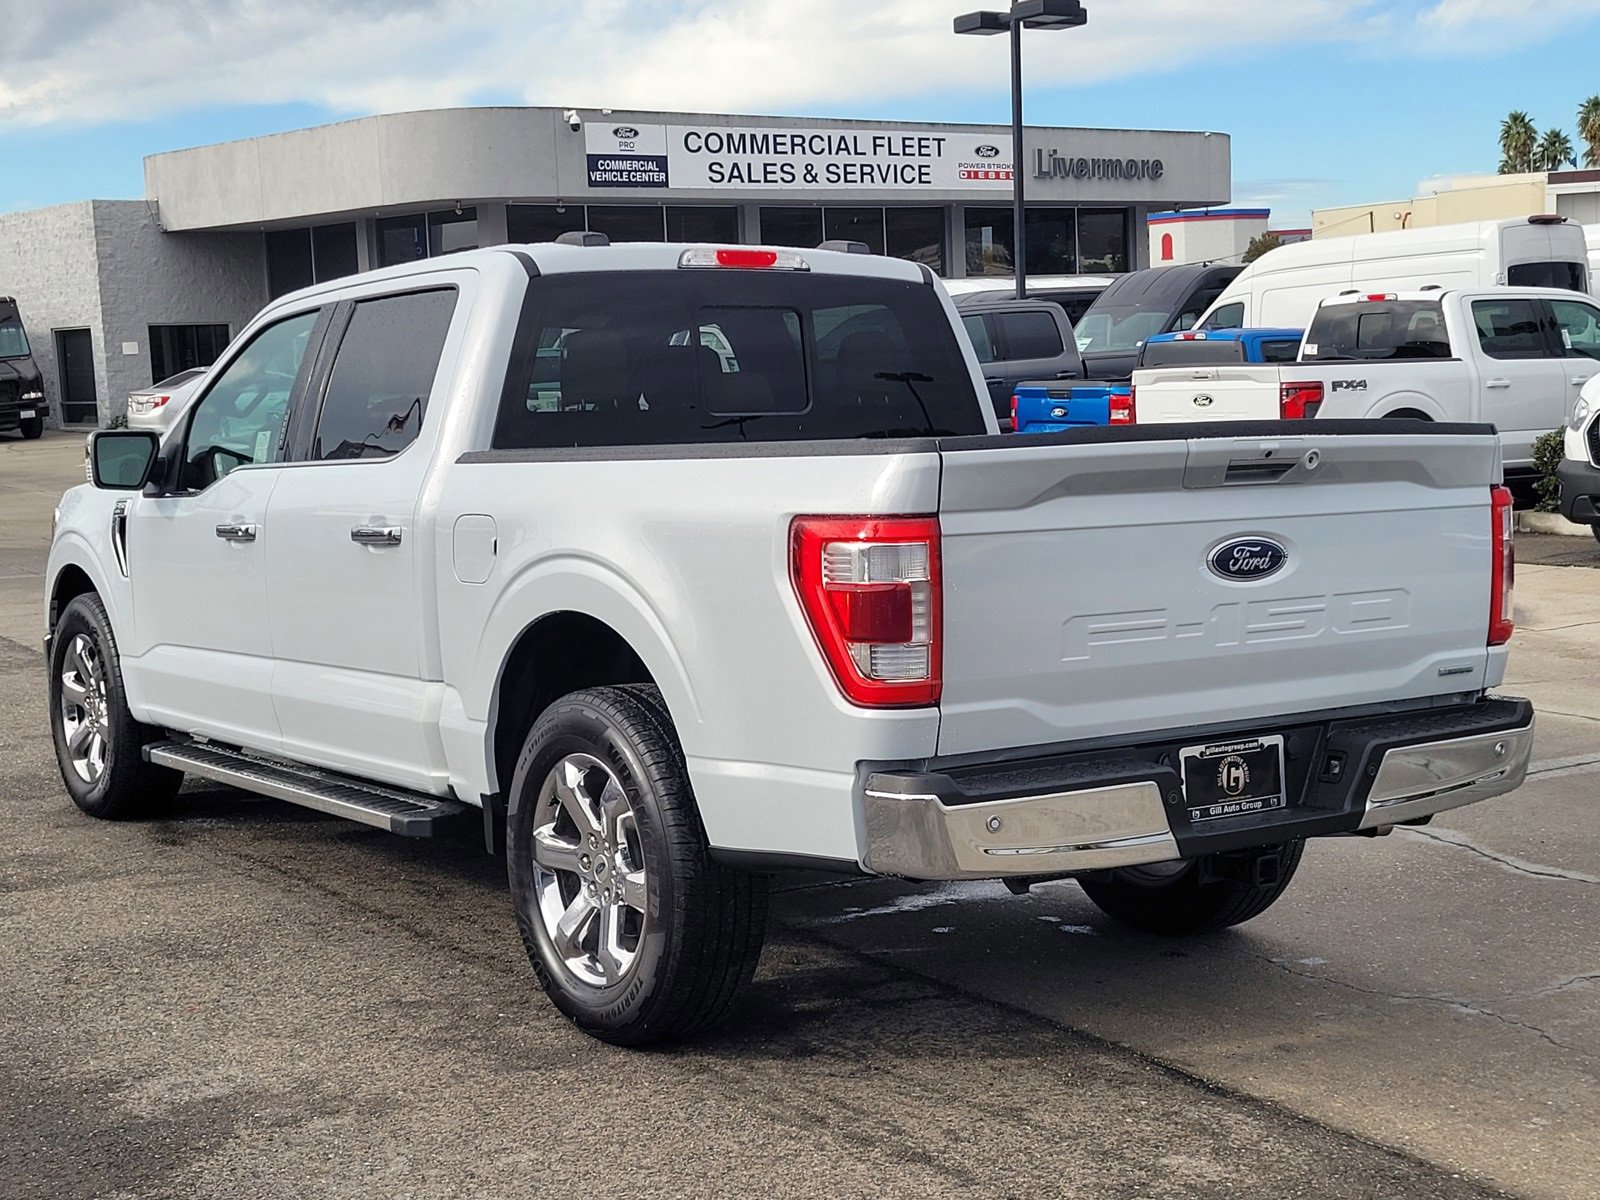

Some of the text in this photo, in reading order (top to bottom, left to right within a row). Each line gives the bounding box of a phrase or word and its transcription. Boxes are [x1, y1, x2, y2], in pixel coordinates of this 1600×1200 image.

[683, 131, 946, 157] COMMERCIAL FLEET
[977, 146, 997, 157] Ford
[598, 160, 660, 171] COMMERCIAL
[1033, 148, 1164, 180] Livermore
[590, 170, 666, 183] VEHICLE CENTER
[708, 162, 932, 184] SALES & SERVICE
[1331, 380, 1368, 392] FX4
[1229, 546, 1272, 572] Ford
[1061, 588, 1410, 662] F-150
[1206, 742, 1258, 755] gillautogroup.com
[1210, 801, 1262, 815] Gill Auto Group
